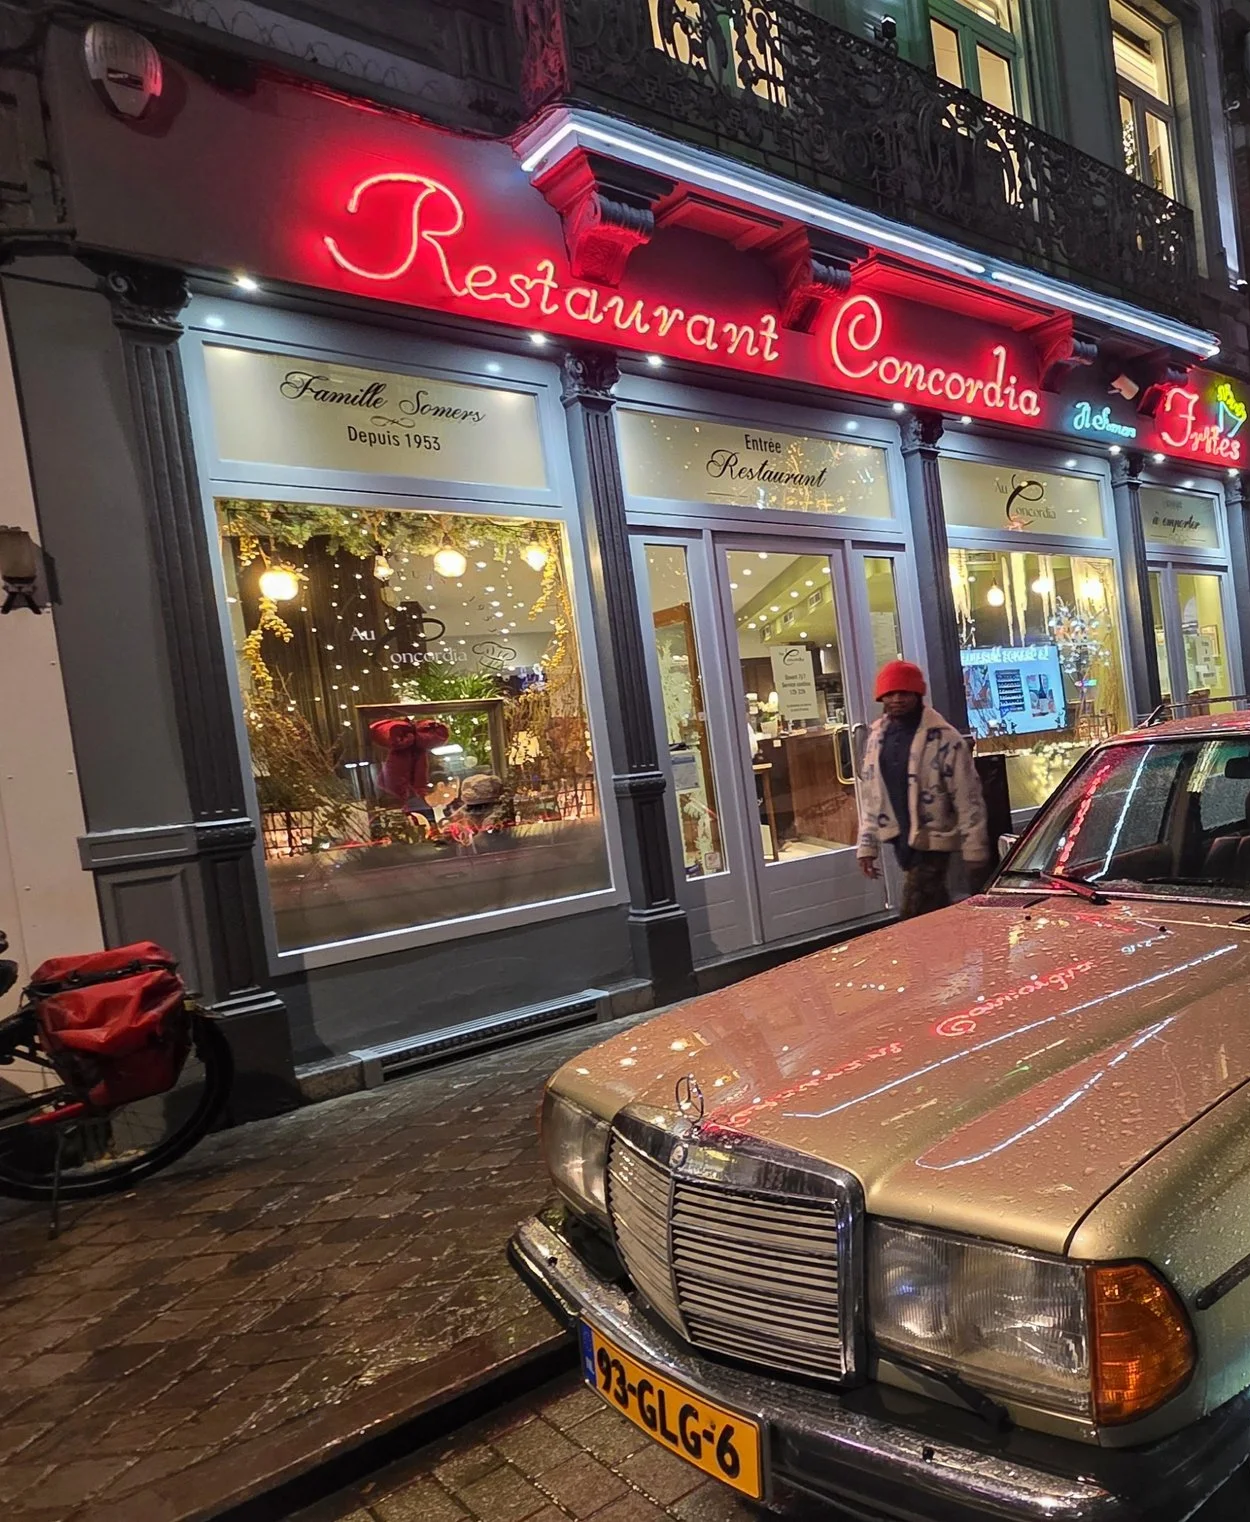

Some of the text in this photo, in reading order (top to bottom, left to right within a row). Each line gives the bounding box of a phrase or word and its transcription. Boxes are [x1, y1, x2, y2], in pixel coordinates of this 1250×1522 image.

[324, 172, 1041, 416] Restaurant Concordia
[280, 371, 486, 423] Famille Somers
[347, 425, 441, 450] Depuis 1953
[744, 434, 781, 453] Entrée
[1161, 387, 1241, 460] Frites
[706, 449, 828, 487] Restaurant
[349, 626, 376, 641] Au
[597, 1347, 740, 1479] 93-GLG-6
